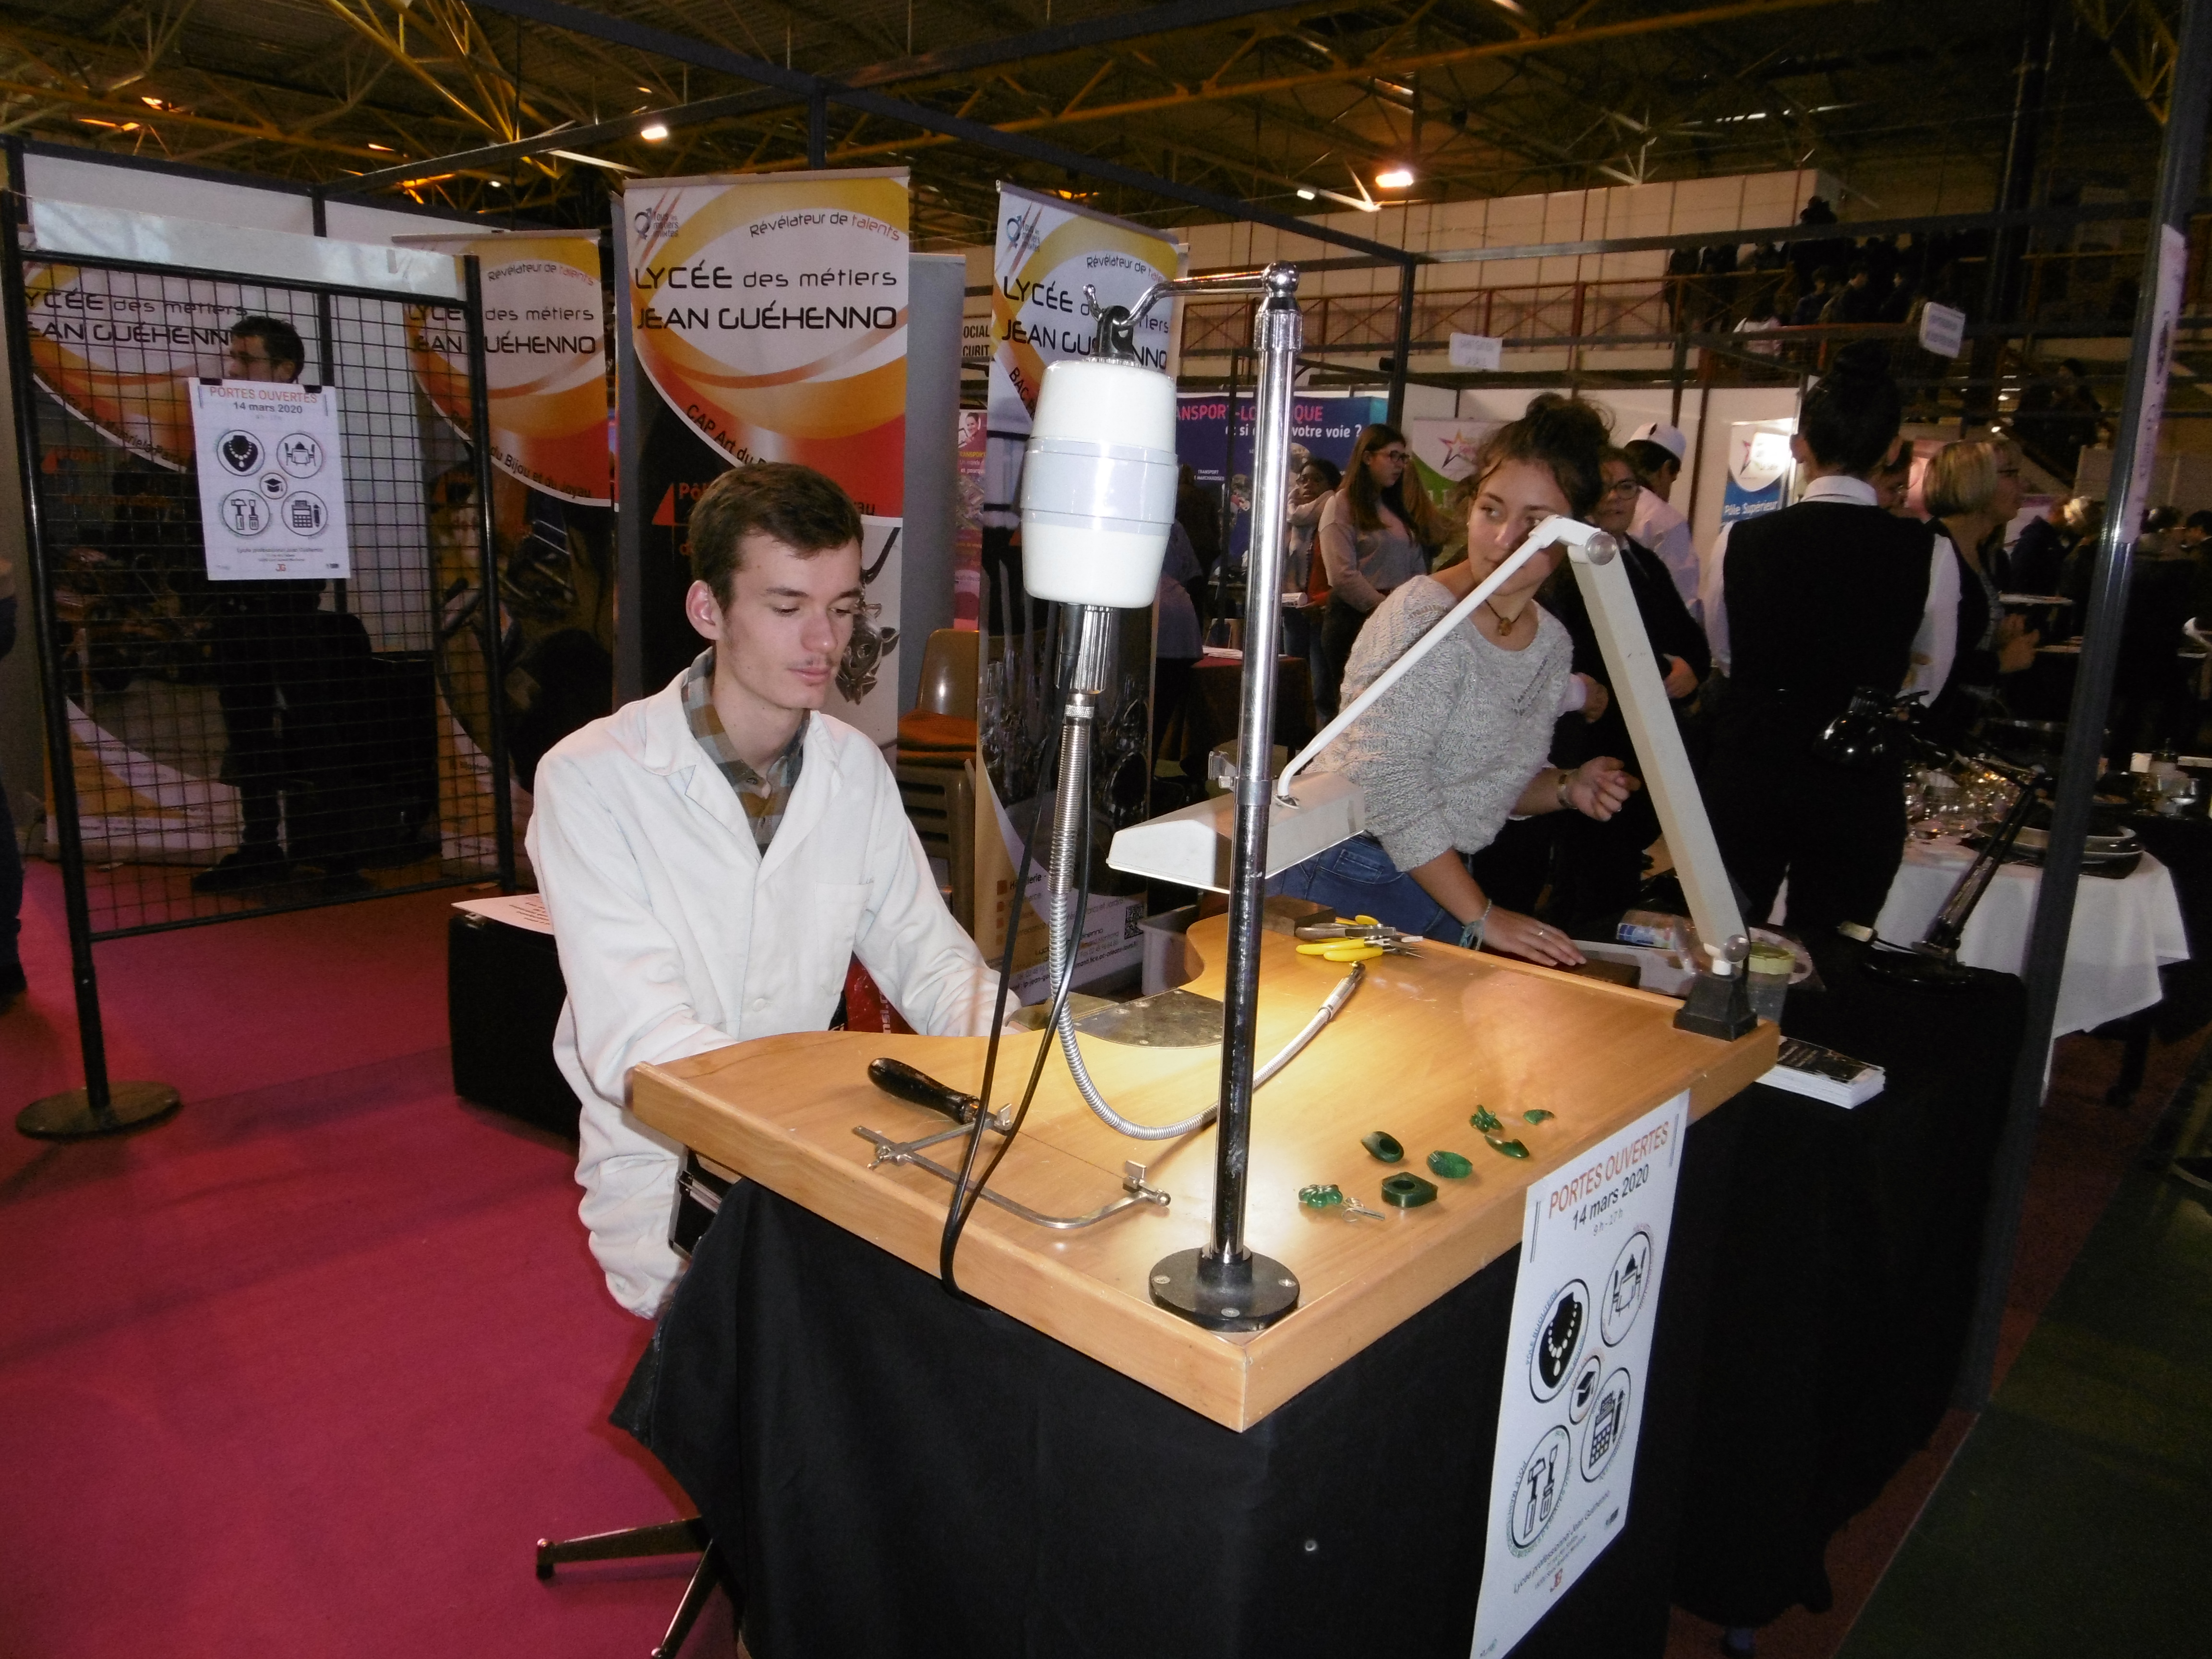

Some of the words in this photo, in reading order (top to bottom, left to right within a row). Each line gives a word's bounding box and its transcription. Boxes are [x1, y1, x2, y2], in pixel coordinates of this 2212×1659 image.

[749, 212, 826, 238] Révélateur
[830, 211, 848, 225] de
[852, 215, 900, 241] talents
[487, 262, 542, 282] Révélateur
[544, 262, 556, 273] de
[559, 265, 595, 287] talents
[635, 259, 733, 289] LYCÉE
[743, 271, 789, 288] des
[799, 268, 897, 287] métiers
[1086, 253, 1133, 269] Révélateur
[1134, 261, 1146, 274] de
[25, 288, 104, 310] YCÉE
[113, 299, 156, 313] des
[1003, 276, 1073, 313] LYCÉE
[485, 308, 518, 321] des
[526, 306, 594, 321] métiers
[637, 307, 709, 330] JEAN
[718, 300, 897, 330] GUÉHENNO
[27, 321, 84, 340] EAN
[93, 322, 233, 346] GUÉHENN
[484, 331, 596, 354] UÉHENNO
[963, 325, 991, 338] OCIAL
[962, 344, 990, 357] CURIT
[1002, 319, 1056, 349] JEAN
[1061, 331, 1168, 370] GUNNO
[209, 386, 255, 399] PORTES
[258, 388, 318, 404] OUVERTES
[1009, 367, 1029, 401] BAC
[234, 402, 246, 411] 14
[249, 403, 275, 412] mars
[278, 404, 303, 414] 2020
[686, 404, 716, 431] CAP
[714, 430, 736, 454] Art
[1291, 423, 1322, 438] votre
[1326, 424, 1351, 438] voie
[1355, 424, 1362, 438] ?
[504, 454, 530, 478] Bijou
[1724, 503, 1741, 516] Pôle
[1741, 500, 1778, 516] Supérieur
[1549, 1163, 1602, 1219] PORTES
[1605, 1121, 1670, 1181] OUVERTES
[1572, 1207, 1587, 1231] 14
[1589, 1188, 1619, 1221] mars
[1621, 1163, 1650, 1198] 2020
[1593, 1226, 1598, 1236] 9
